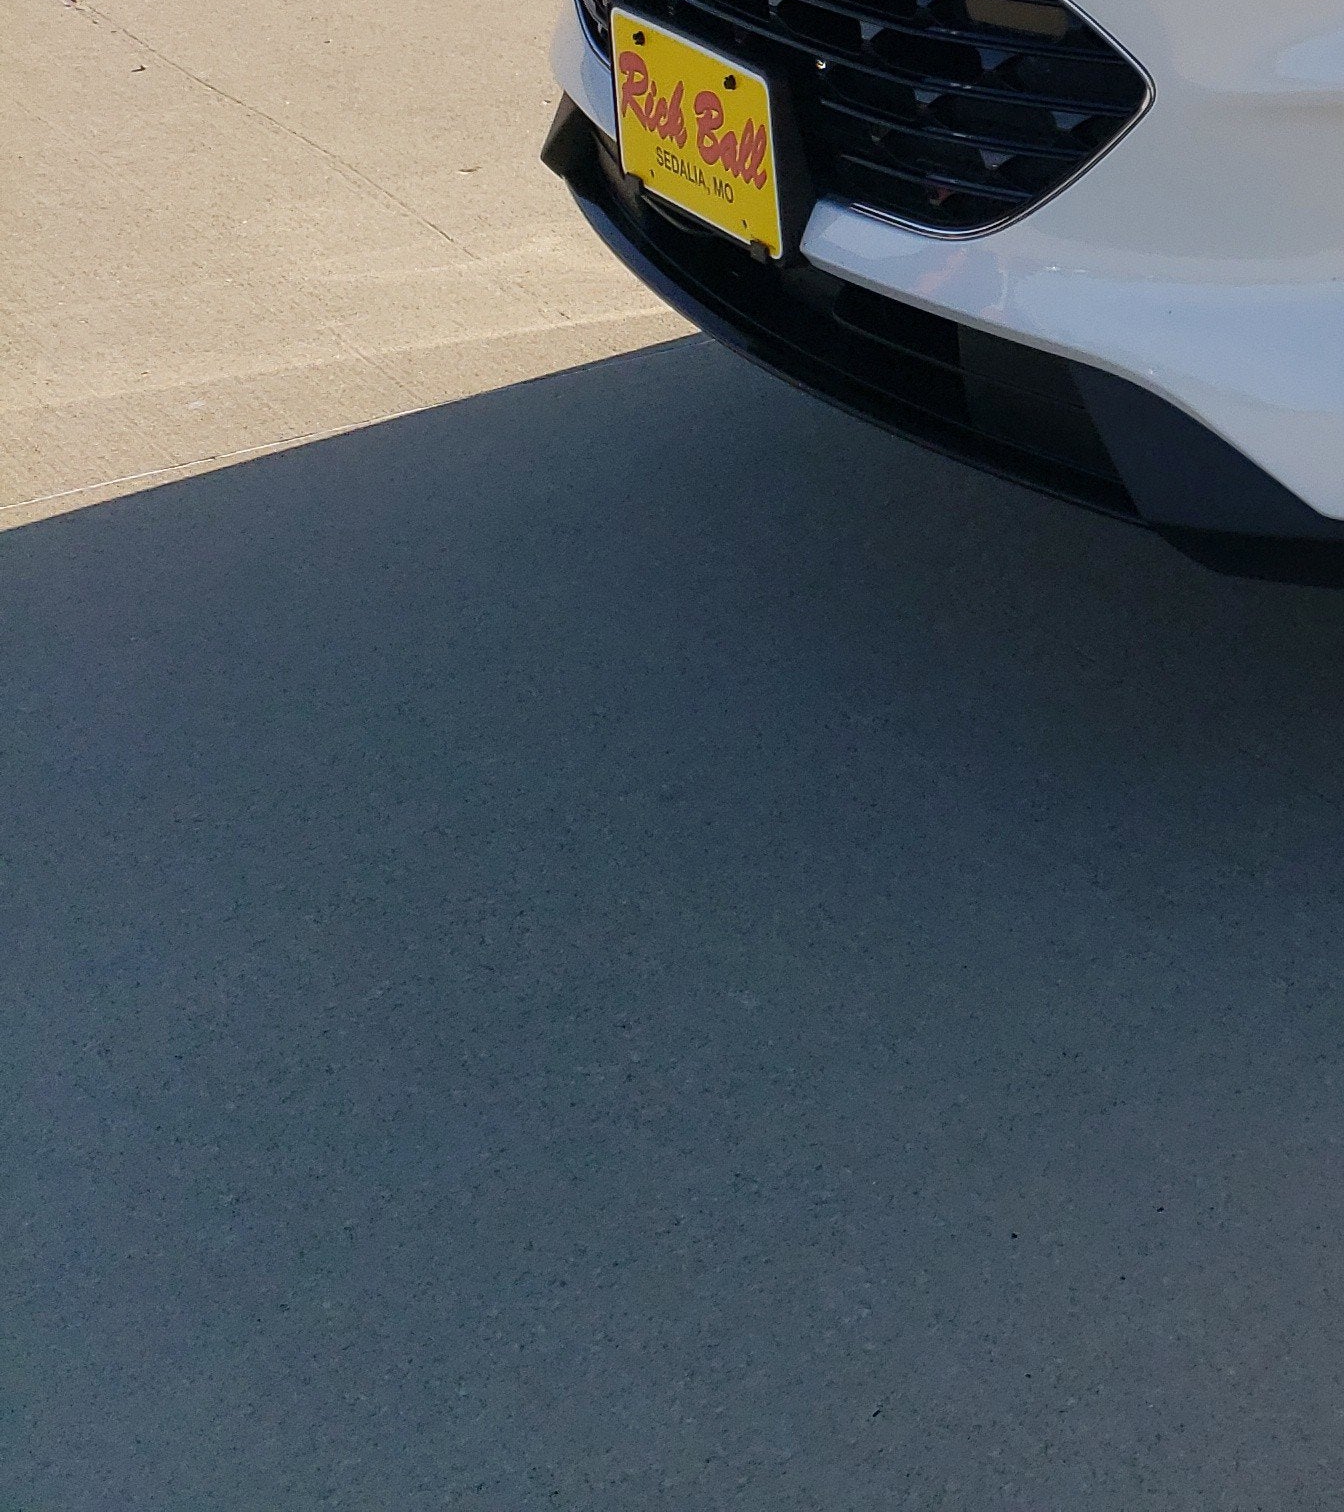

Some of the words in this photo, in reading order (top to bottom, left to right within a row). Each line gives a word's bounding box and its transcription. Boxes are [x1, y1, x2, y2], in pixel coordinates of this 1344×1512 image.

[619, 51, 687, 149] Rich
[694, 90, 767, 189] Ball
[655, 146, 711, 196] SEDALIA,
[712, 178, 734, 204] MO
